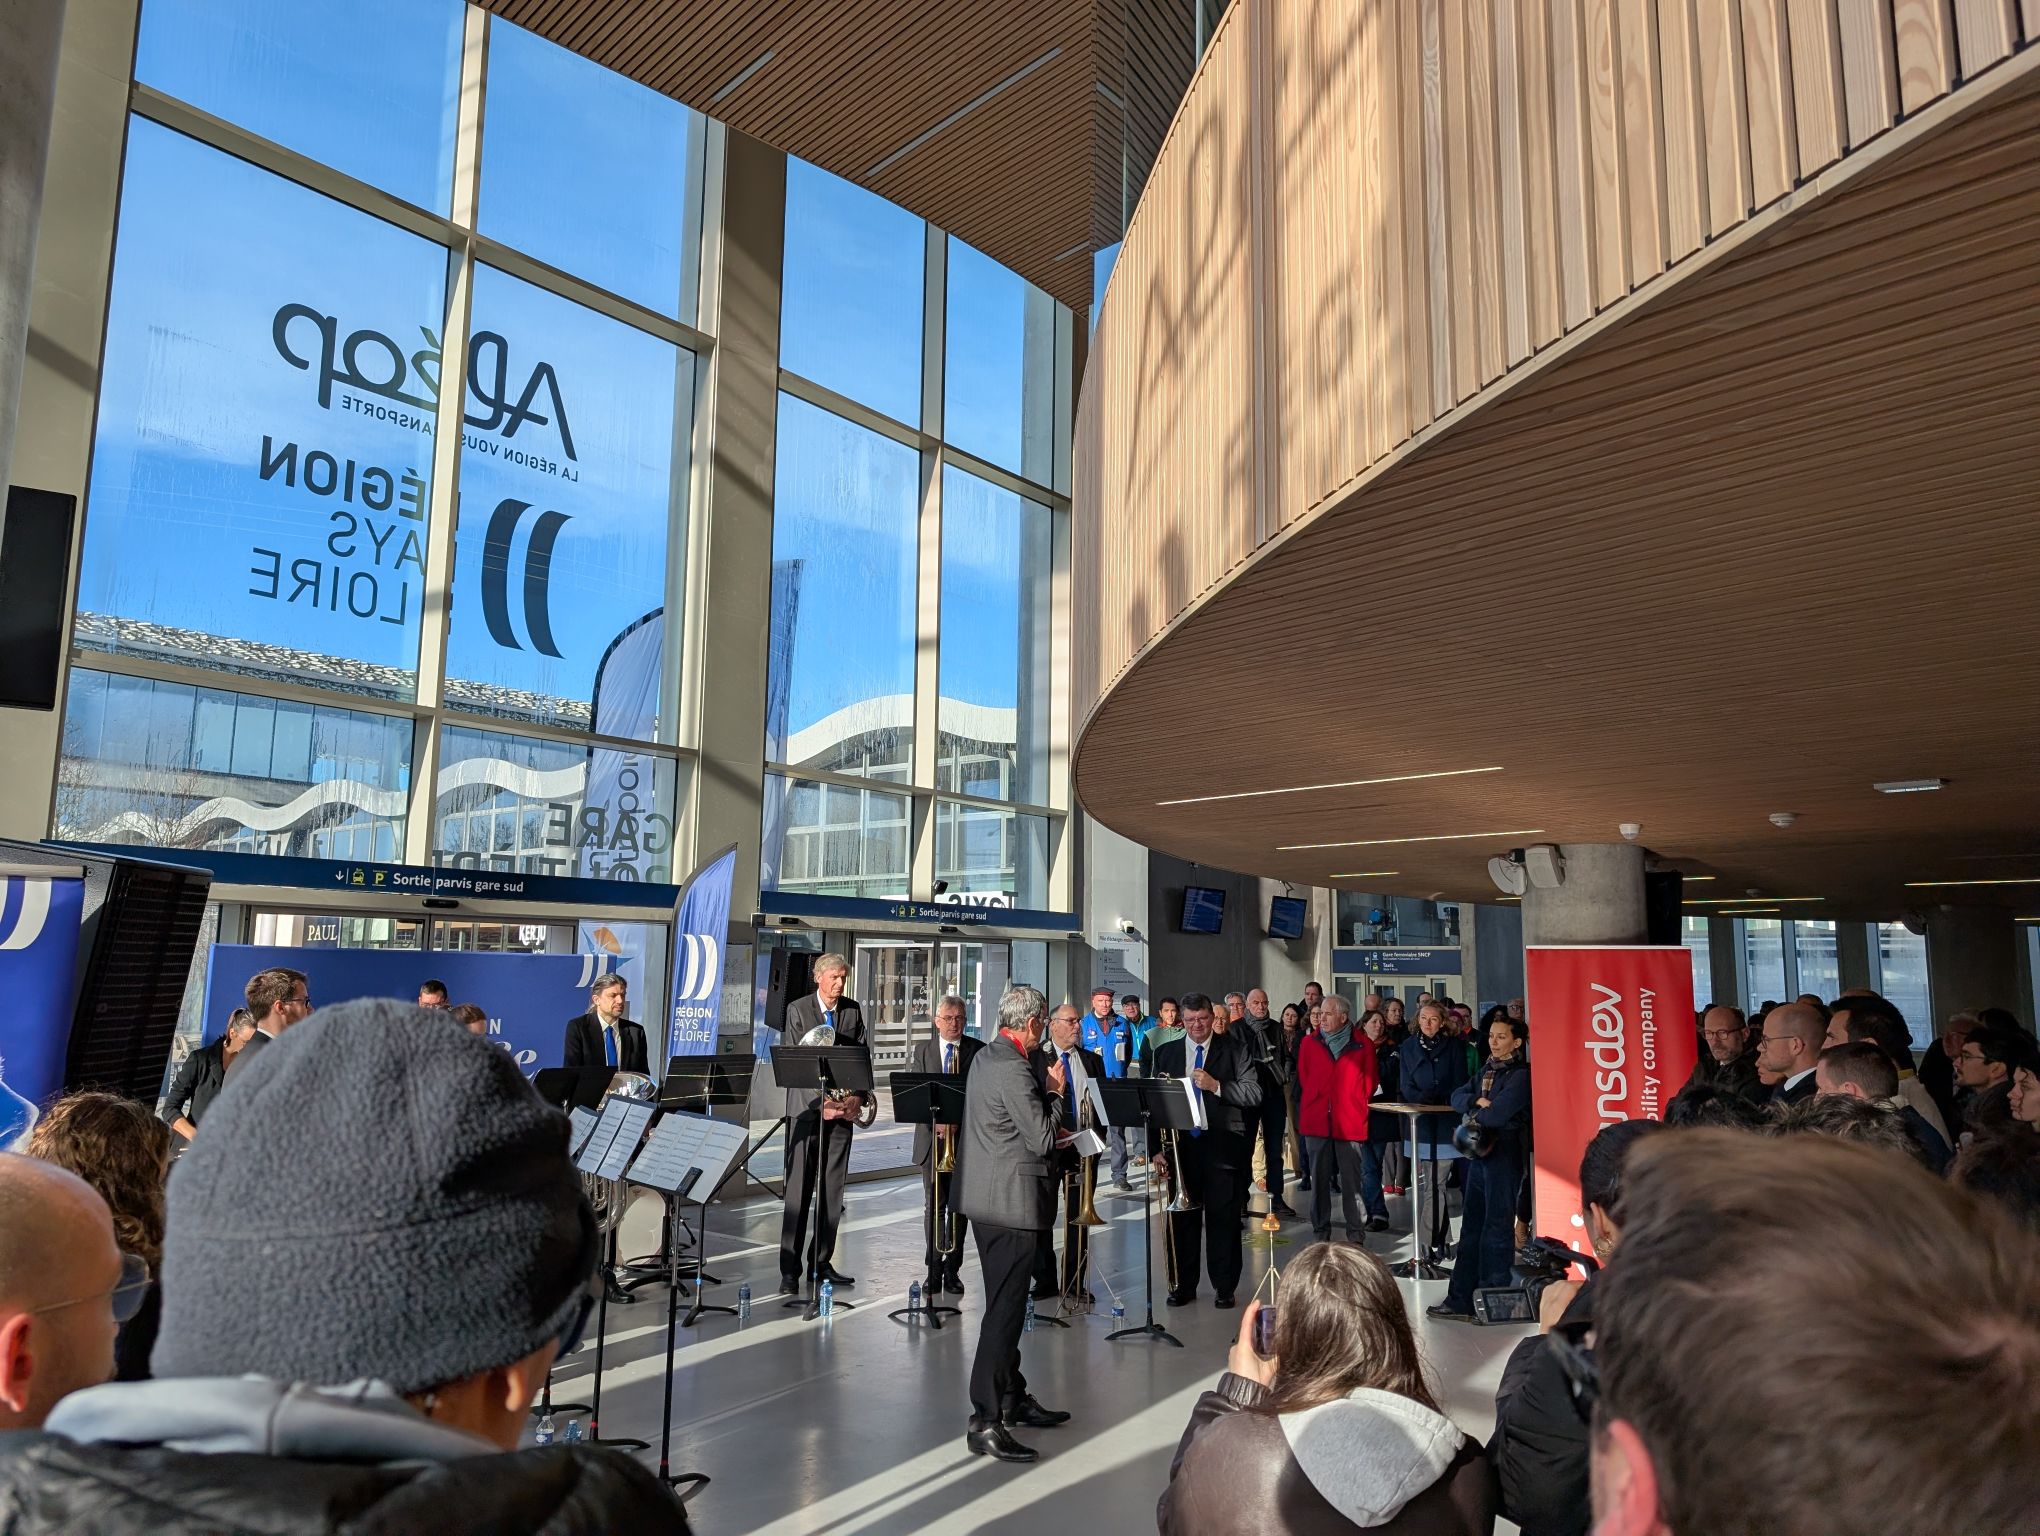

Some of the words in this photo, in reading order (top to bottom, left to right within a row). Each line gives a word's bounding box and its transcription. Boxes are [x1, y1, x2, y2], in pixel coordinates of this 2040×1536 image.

[393, 872, 431, 887] Sortie
[436, 875, 472, 890] parvis
[475, 880, 500, 893] gare
[504, 881, 524, 893] sud
[919, 907, 940, 917] Sortie
[941, 909, 960, 920] parvis
[961, 911, 975, 921] gare
[976, 911, 987, 920] sud
[307, 924, 338, 941] PAUL
[675, 1005, 713, 1018] RÉGION
[674, 1018, 699, 1030] PAYS
[1640, 987, 1658, 1070] company
[680, 1030, 710, 1041] LOIRE
[1585, 983, 1629, 1129] nsdev
[1640, 1075, 1661, 1121] ility
